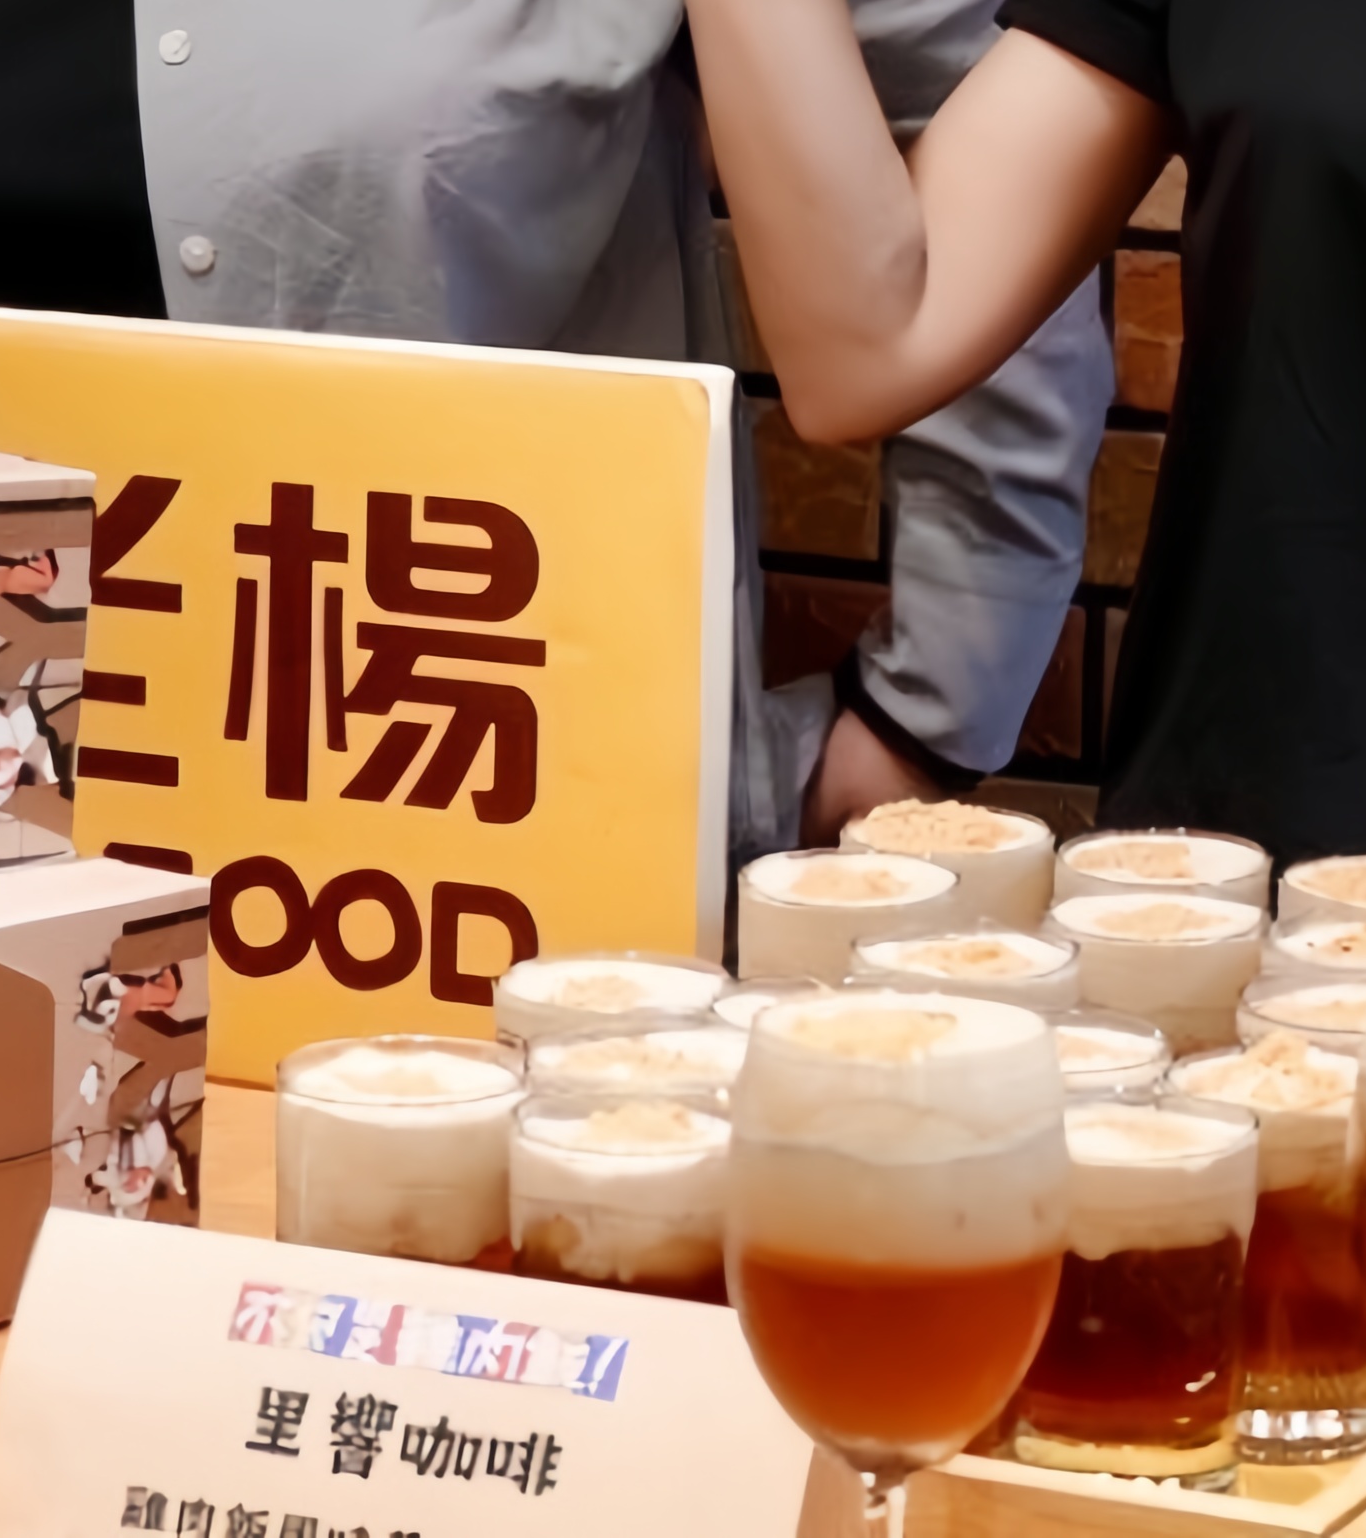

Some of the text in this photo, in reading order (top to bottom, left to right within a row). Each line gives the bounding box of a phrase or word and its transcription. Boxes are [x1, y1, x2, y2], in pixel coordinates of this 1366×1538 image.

[103, 842, 539, 1007] OOD
[245, 1387, 562, 1496] 里響咖啡
